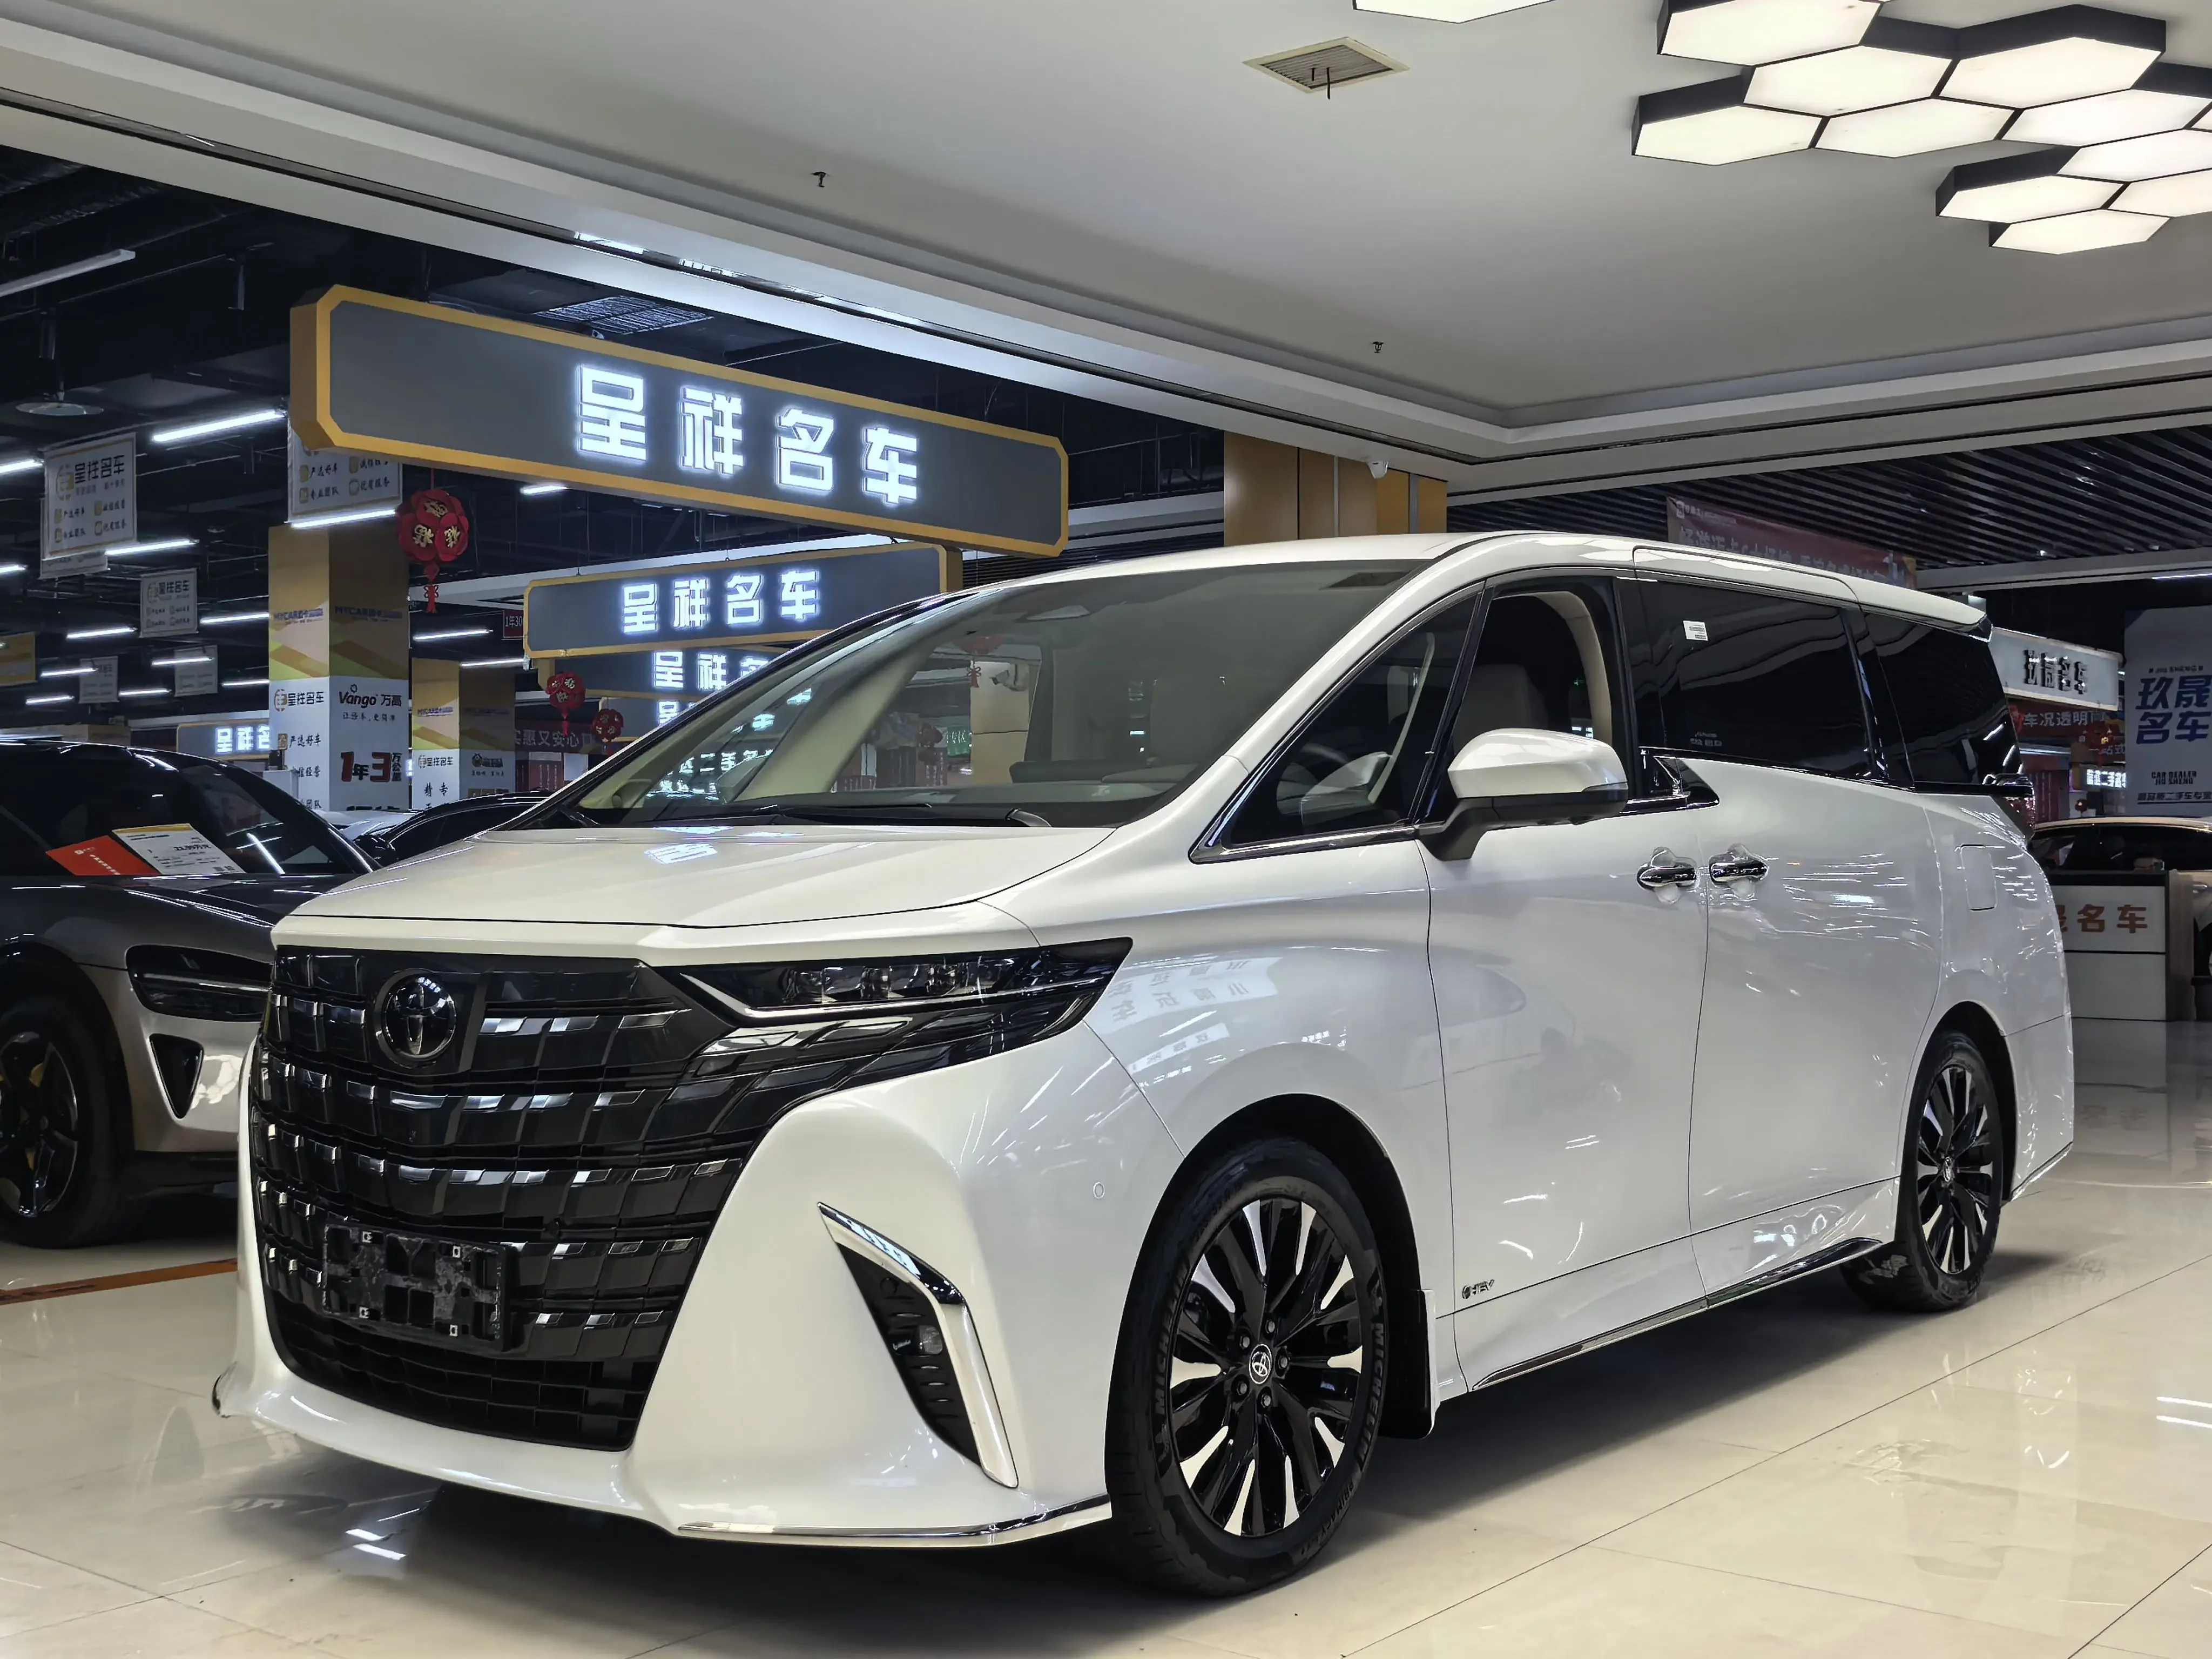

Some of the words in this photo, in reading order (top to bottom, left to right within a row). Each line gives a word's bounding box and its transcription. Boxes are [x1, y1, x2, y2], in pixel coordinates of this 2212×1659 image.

[577, 363, 918, 505] 呈祥名车
[75, 455, 125, 484] 呈祥名车
[622, 568, 819, 634] 呈祥名车
[288, 691, 325, 706] 呈祥名车
[339, 691, 377, 709] Vango
[2135, 675, 2212, 710] 玖晟
[2023, 711, 2088, 727] 车况透明
[2136, 711, 2211, 745] 名车
[288, 733, 321, 747] 严选好车
[1357, 1323, 1385, 1464] MICHELIN
